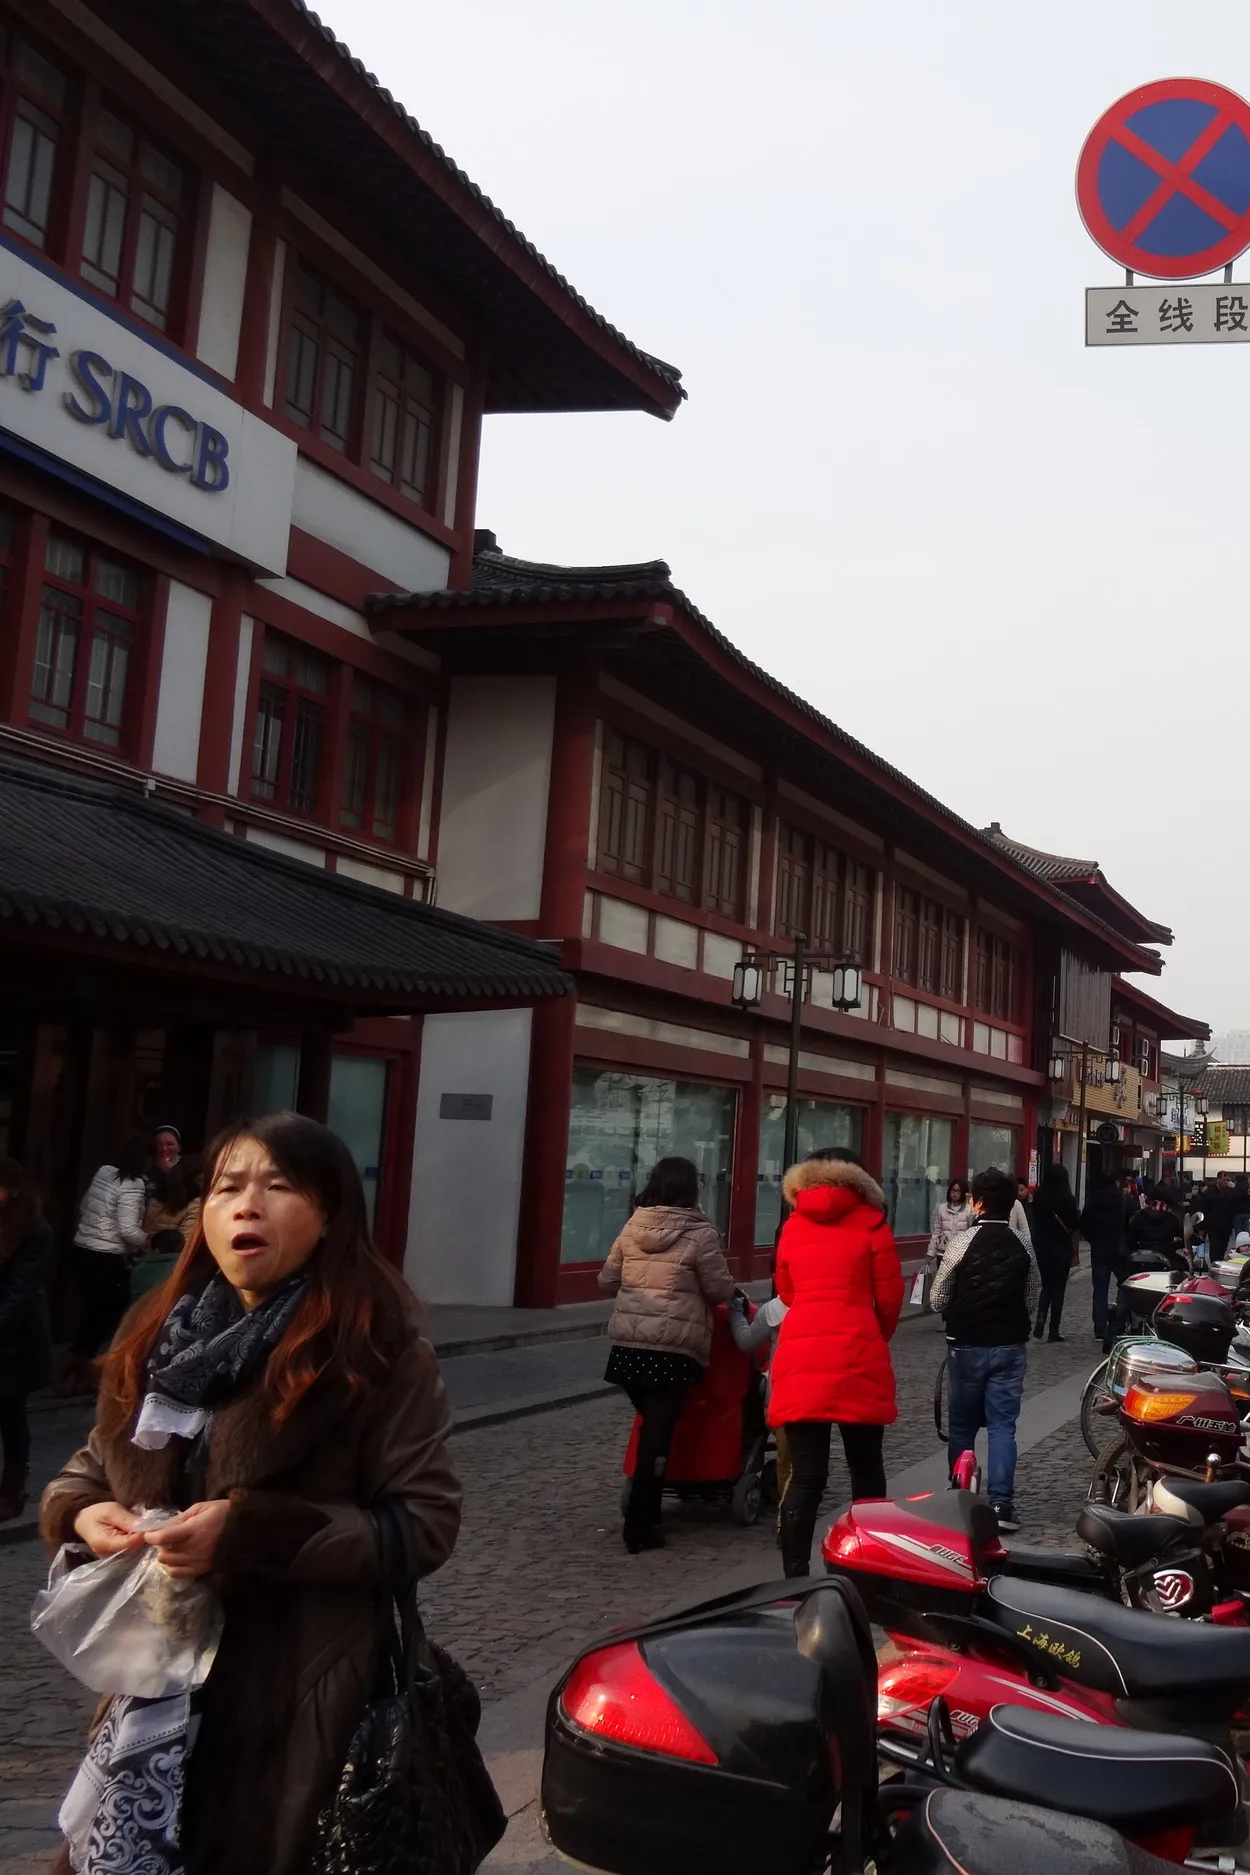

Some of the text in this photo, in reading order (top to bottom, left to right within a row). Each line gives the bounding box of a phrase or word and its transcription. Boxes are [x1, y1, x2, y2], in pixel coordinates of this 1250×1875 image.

[1105, 295, 1249, 334] 全线段
[63, 350, 230, 492] SRCB
[1176, 1415, 1237, 1433] 广州五羊
